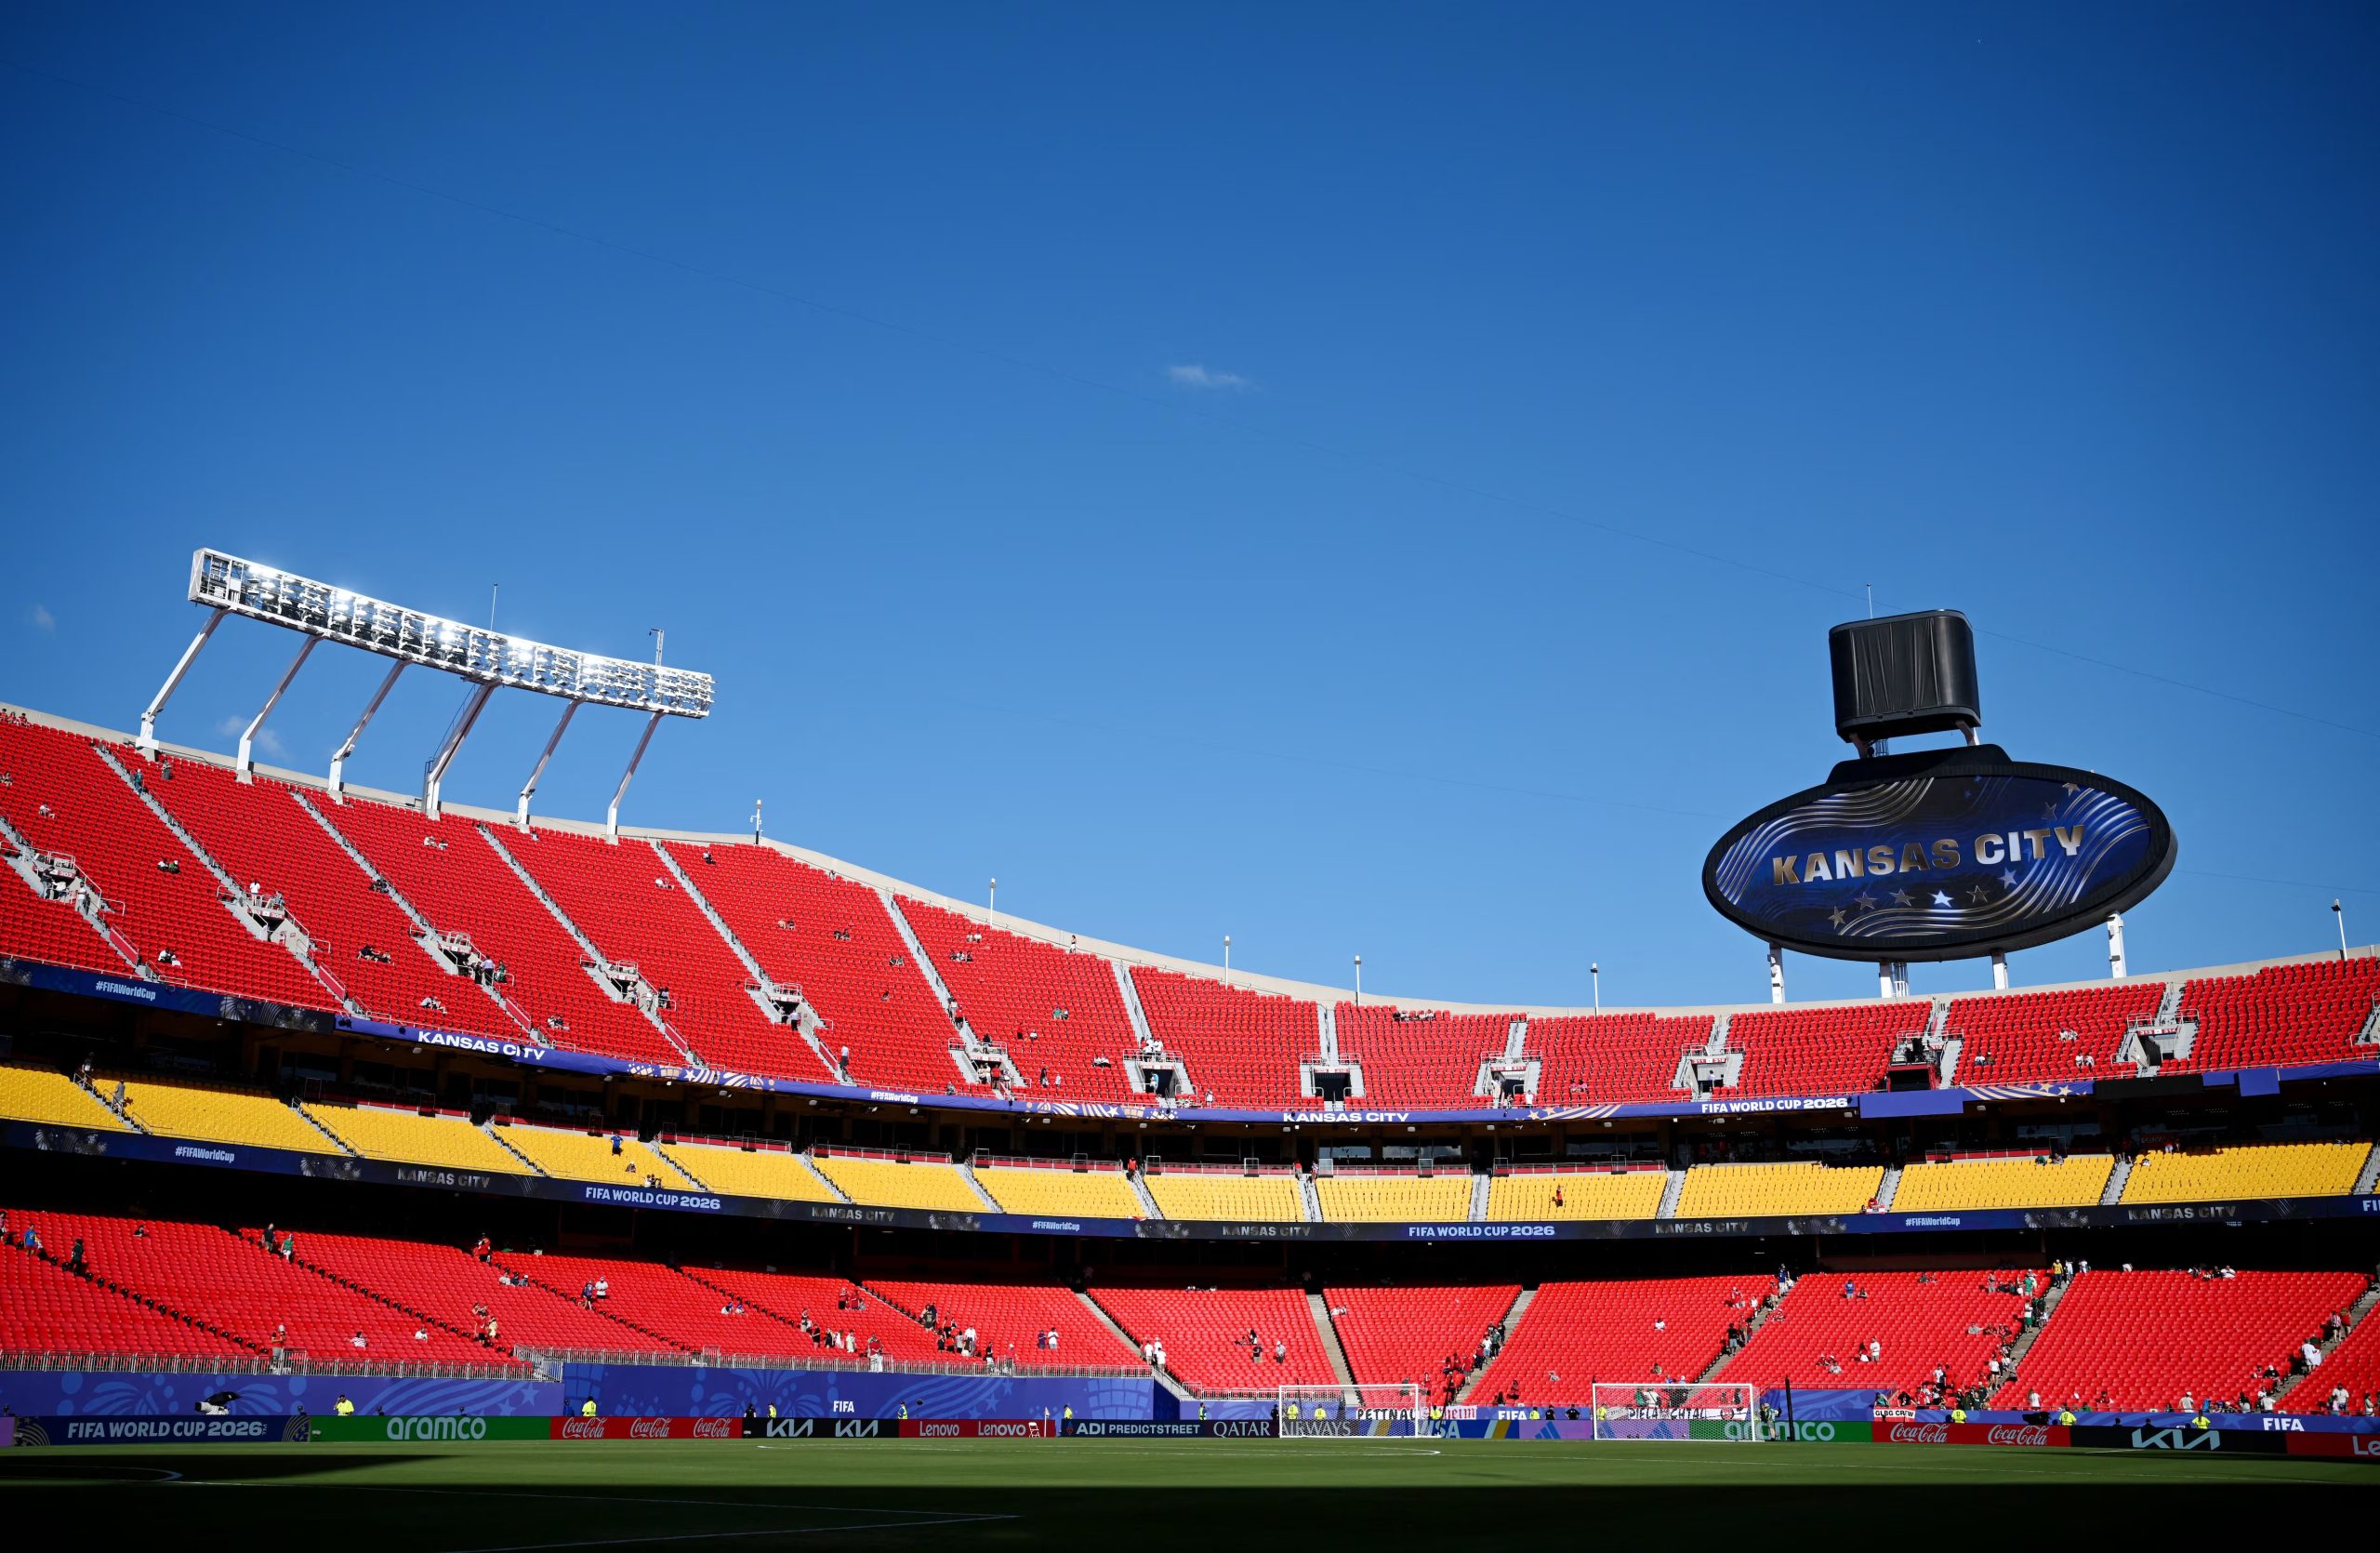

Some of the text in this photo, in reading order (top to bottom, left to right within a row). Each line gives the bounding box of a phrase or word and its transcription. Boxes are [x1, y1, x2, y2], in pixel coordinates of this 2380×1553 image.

[1772, 824, 2085, 885] KANSAS CITY
[96, 980, 156, 1002] #FIFAWorldCup
[418, 1030, 546, 1060] KANSAS CITY
[870, 1091, 919, 1104] #FIFAWorldCup
[1701, 1098, 1848, 1113] FIFA WORLD CUP 2026
[1283, 1112, 1409, 1122] KANSAS CITY
[175, 1146, 235, 1163] #FIFAWorldCup
[397, 1167, 491, 1188] KANSAS CITY
[586, 1187, 721, 1209] FIFA WORLD CUP 2026
[2362, 1200, 2380, 1212] FI
[812, 1206, 894, 1222] KANSAS CITY
[2128, 1205, 2236, 1220] KANSAS CITY
[1032, 1220, 1080, 1232] #FIFAWorldCup
[1655, 1221, 1749, 1234] KANSAS CITY
[1905, 1216, 1961, 1227] #FIFAWorldCup
[1223, 1226, 1311, 1237] KANSAS CITY
[1408, 1226, 1555, 1237] FIFA WORLD CUP 2026
[833, 1400, 854, 1413] FIFA
[1498, 1410, 1527, 1420] FIFA
[67, 1422, 105, 1439] FIFA
[109, 1422, 171, 1438] WORLD
[173, 1421, 206, 1437] CUP
[207, 1421, 263, 1437] 2026
[387, 1416, 486, 1440] aramco
[562, 1416, 606, 1439] Coca-Cola
[629, 1416, 671, 1439] Coca-Cola
[693, 1416, 731, 1439] Coca-Cola
[919, 1421, 959, 1437] Lenovo
[978, 1421, 1026, 1437] Lenovo
[1076, 1423, 1201, 1435] ADI PREDICTSTREET
[1213, 1420, 1353, 1438] QATAR AIRWAYS
[1419, 1420, 1461, 1439] VISA
[1890, 1422, 1950, 1442] Coca-Cola
[2263, 1417, 2305, 1431] FIFA
[1988, 1424, 2050, 1445] Coca-Cola
